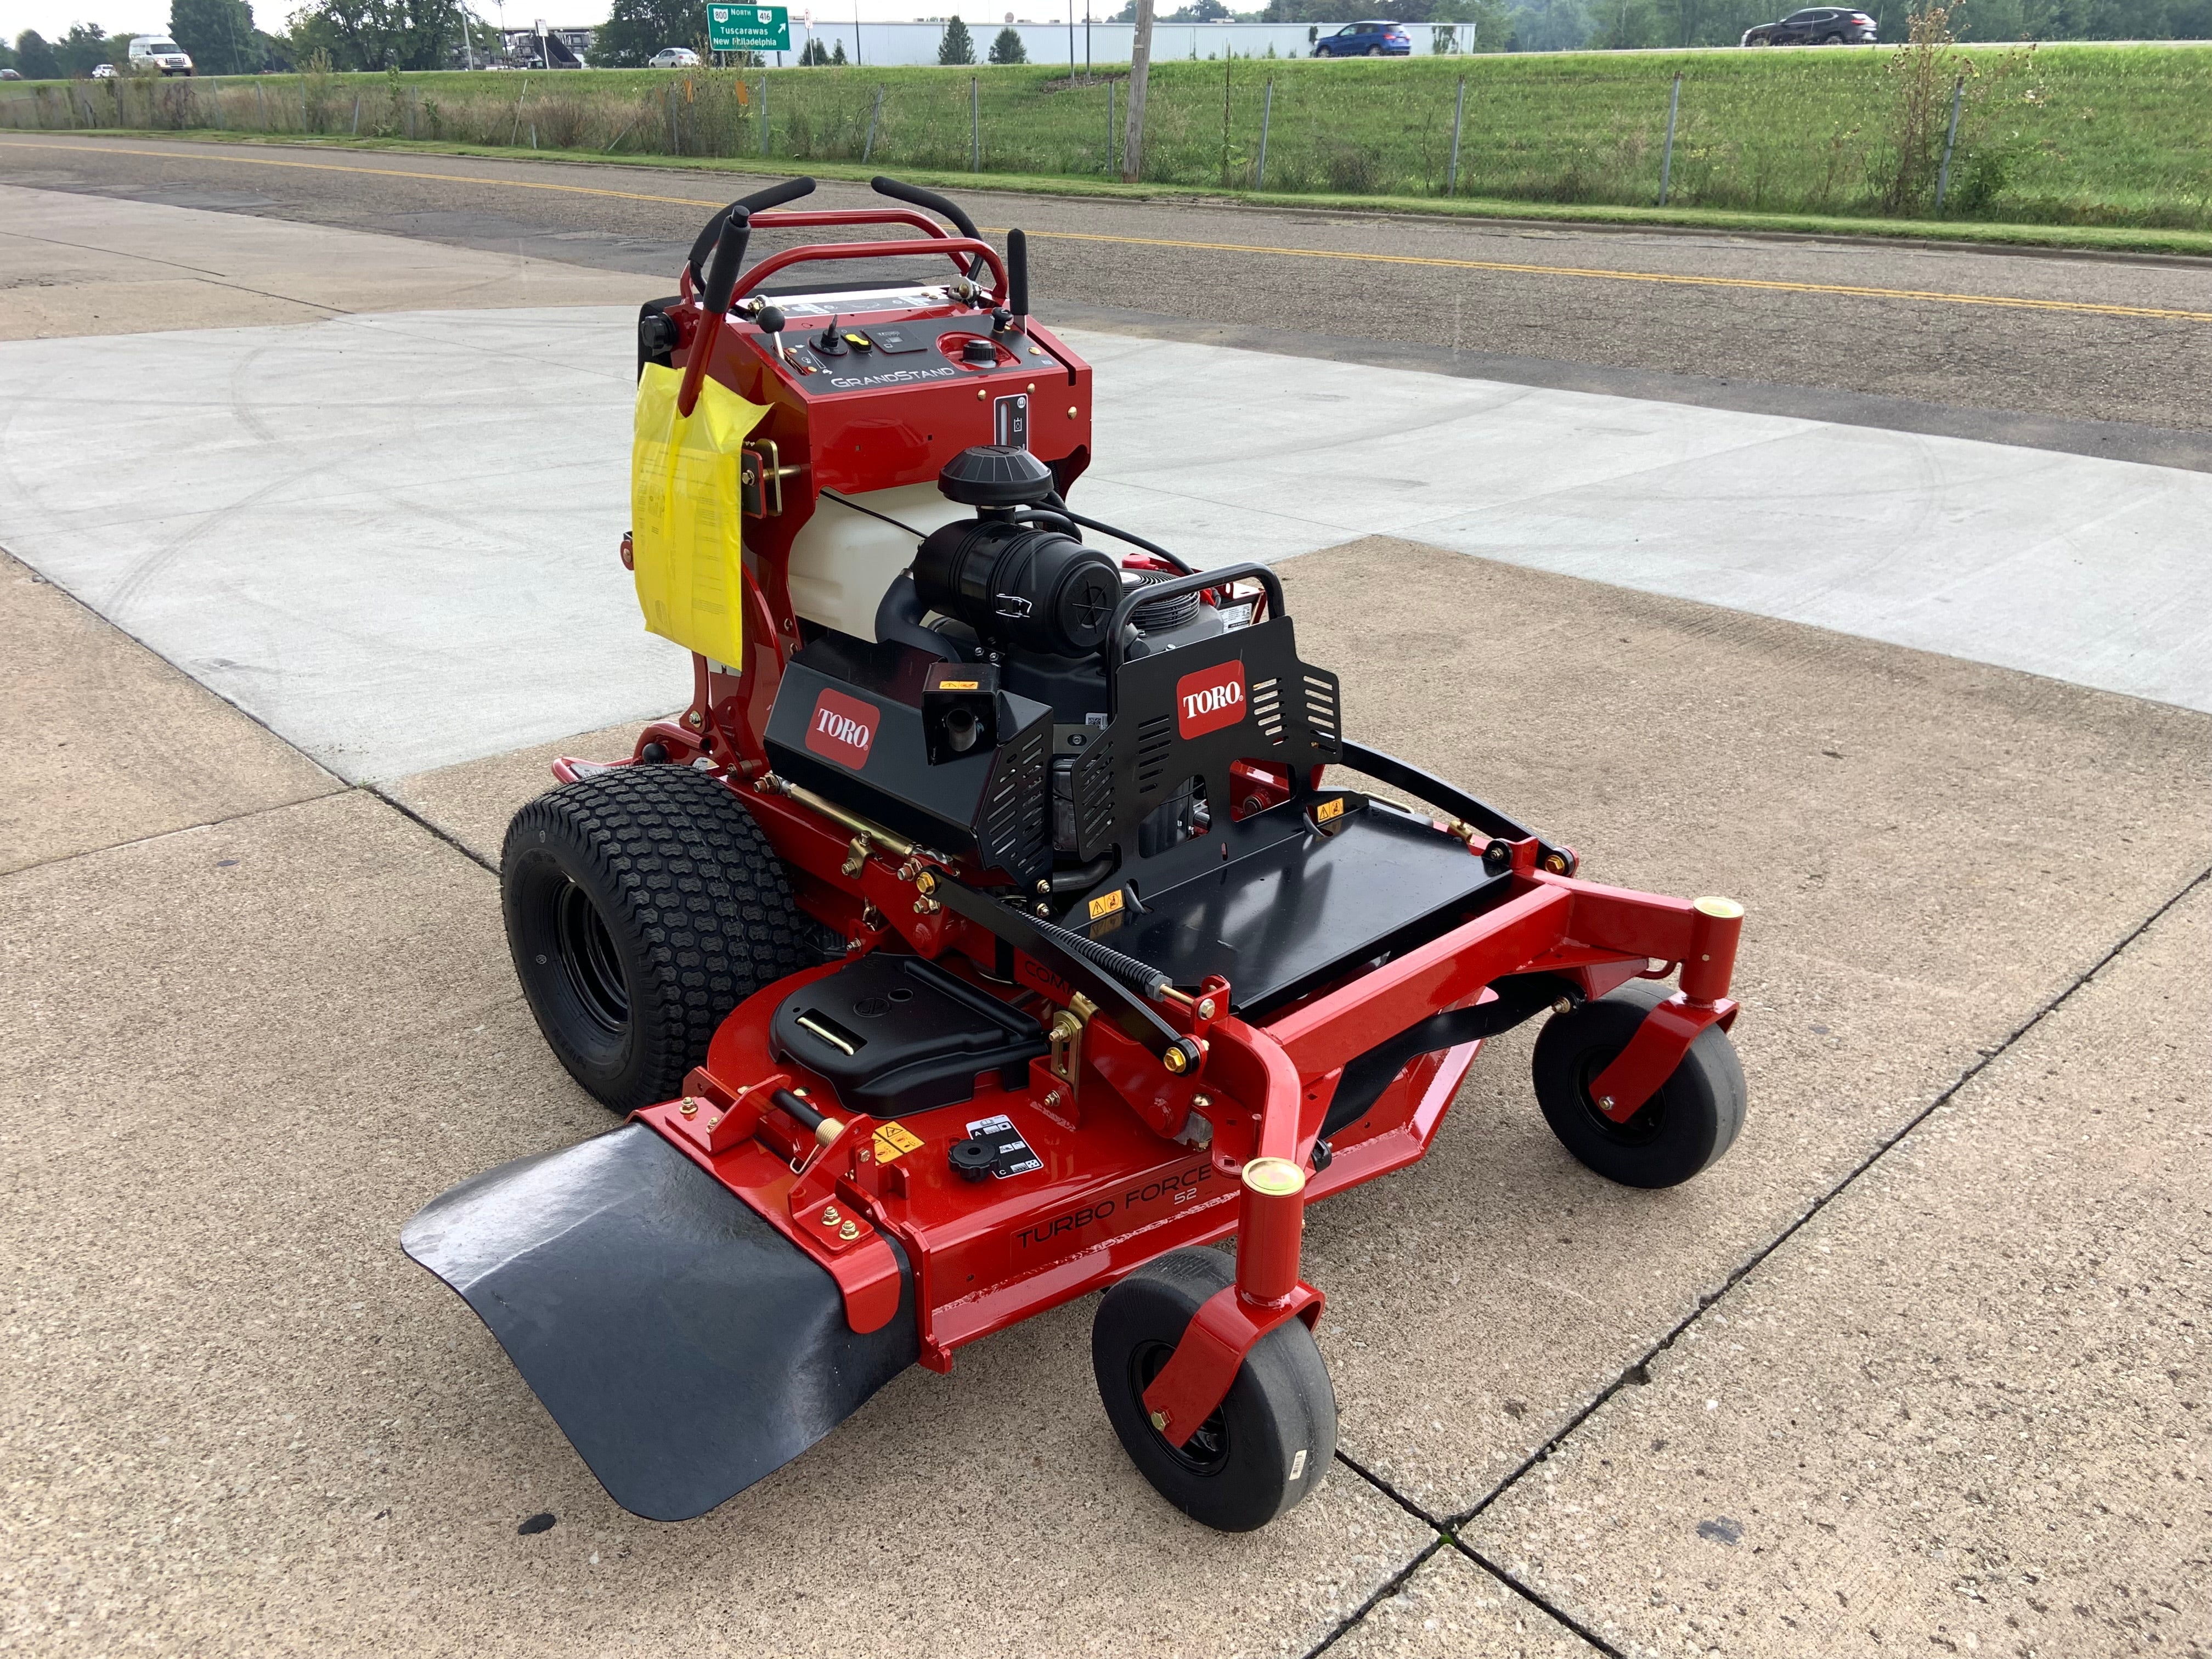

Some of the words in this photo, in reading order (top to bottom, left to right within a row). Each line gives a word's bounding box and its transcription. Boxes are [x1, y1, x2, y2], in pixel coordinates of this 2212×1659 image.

[715, 11, 727, 20] 800
[731, 8, 751, 16] NORTH
[759, 12, 771, 21] 416
[720, 26, 768, 35] Tuscarawas
[732, 37, 777, 48] Philadelphia
[1183, 681, 1240, 719] TORO
[816, 708, 869, 748] TORO
[1174, 1187, 1198, 1205] 52
[1017, 1200, 1115, 1249] TURBO
[1125, 1163, 1212, 1210] FORCE
